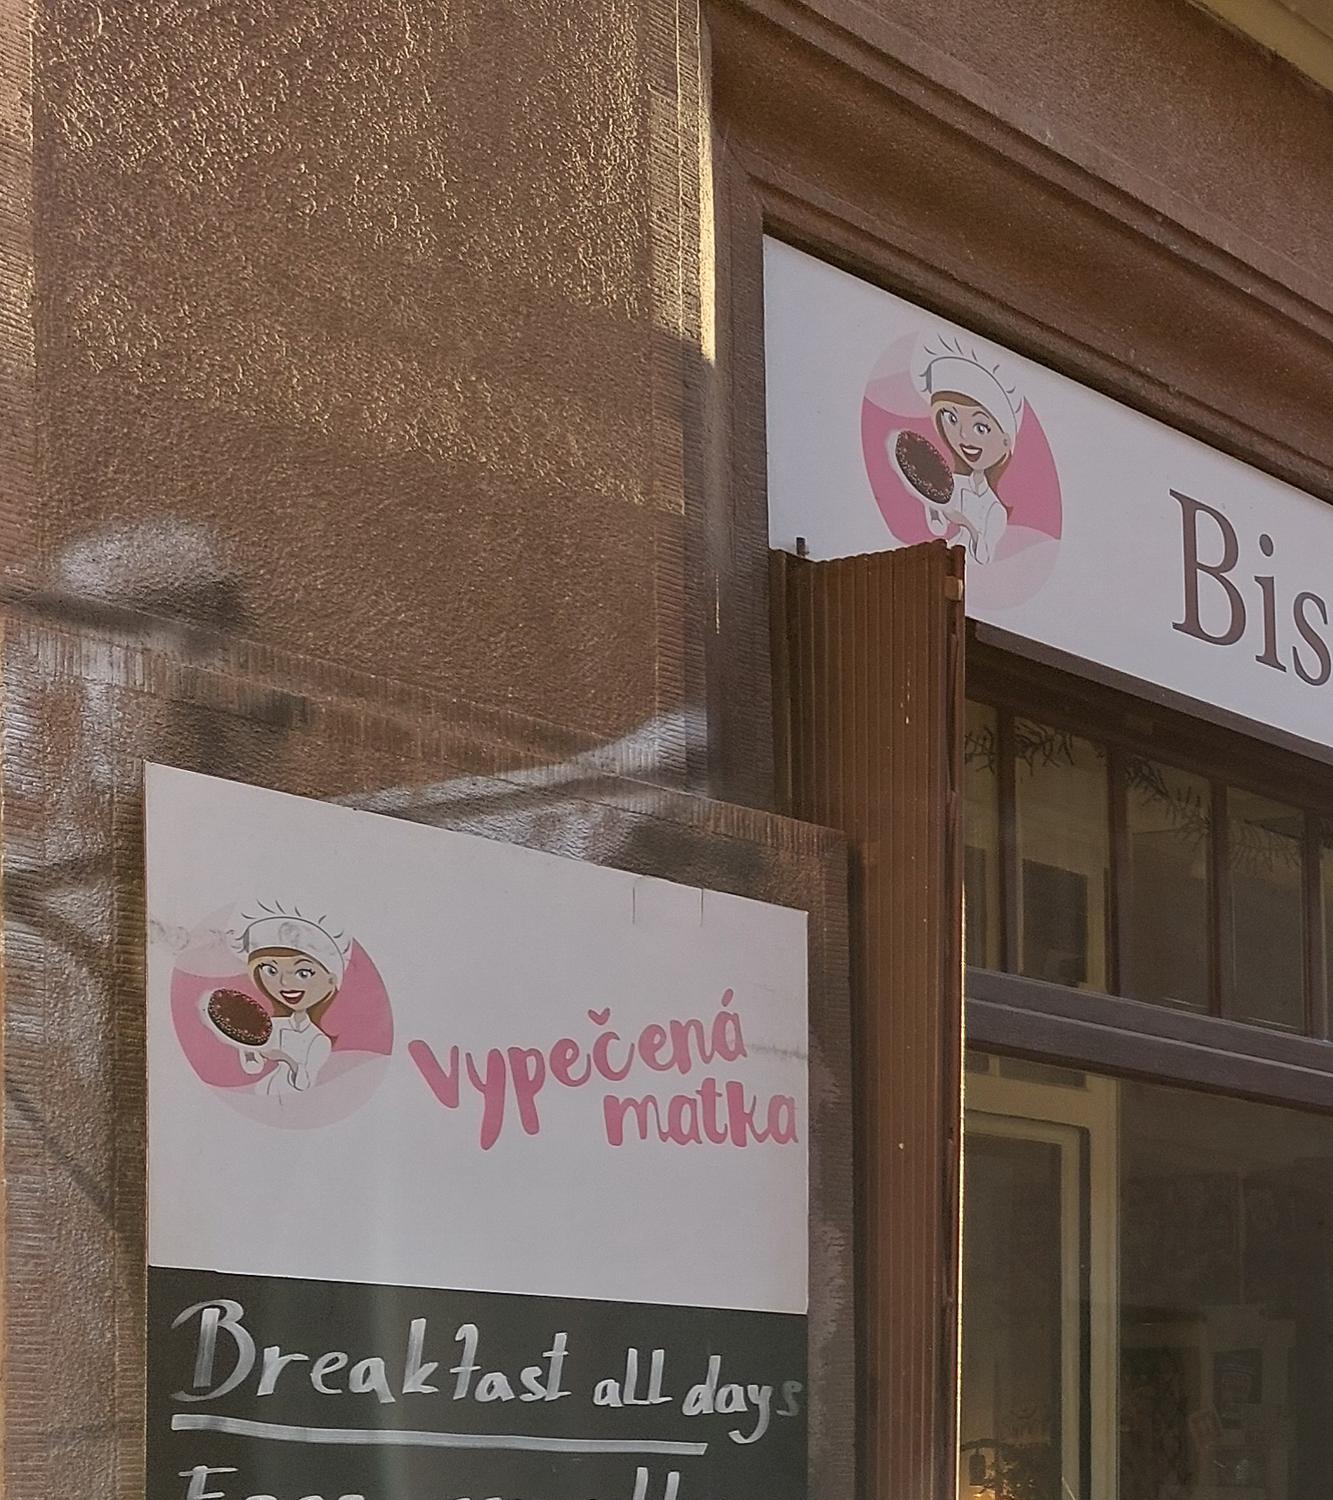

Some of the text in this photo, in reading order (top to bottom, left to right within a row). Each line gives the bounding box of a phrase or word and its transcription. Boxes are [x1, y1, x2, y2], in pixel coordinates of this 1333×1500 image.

[408, 988, 748, 1151] vypečená
[603, 1077, 799, 1148] matka
[171, 1298, 570, 1403] Breakfast
[593, 1347, 673, 1407] all
